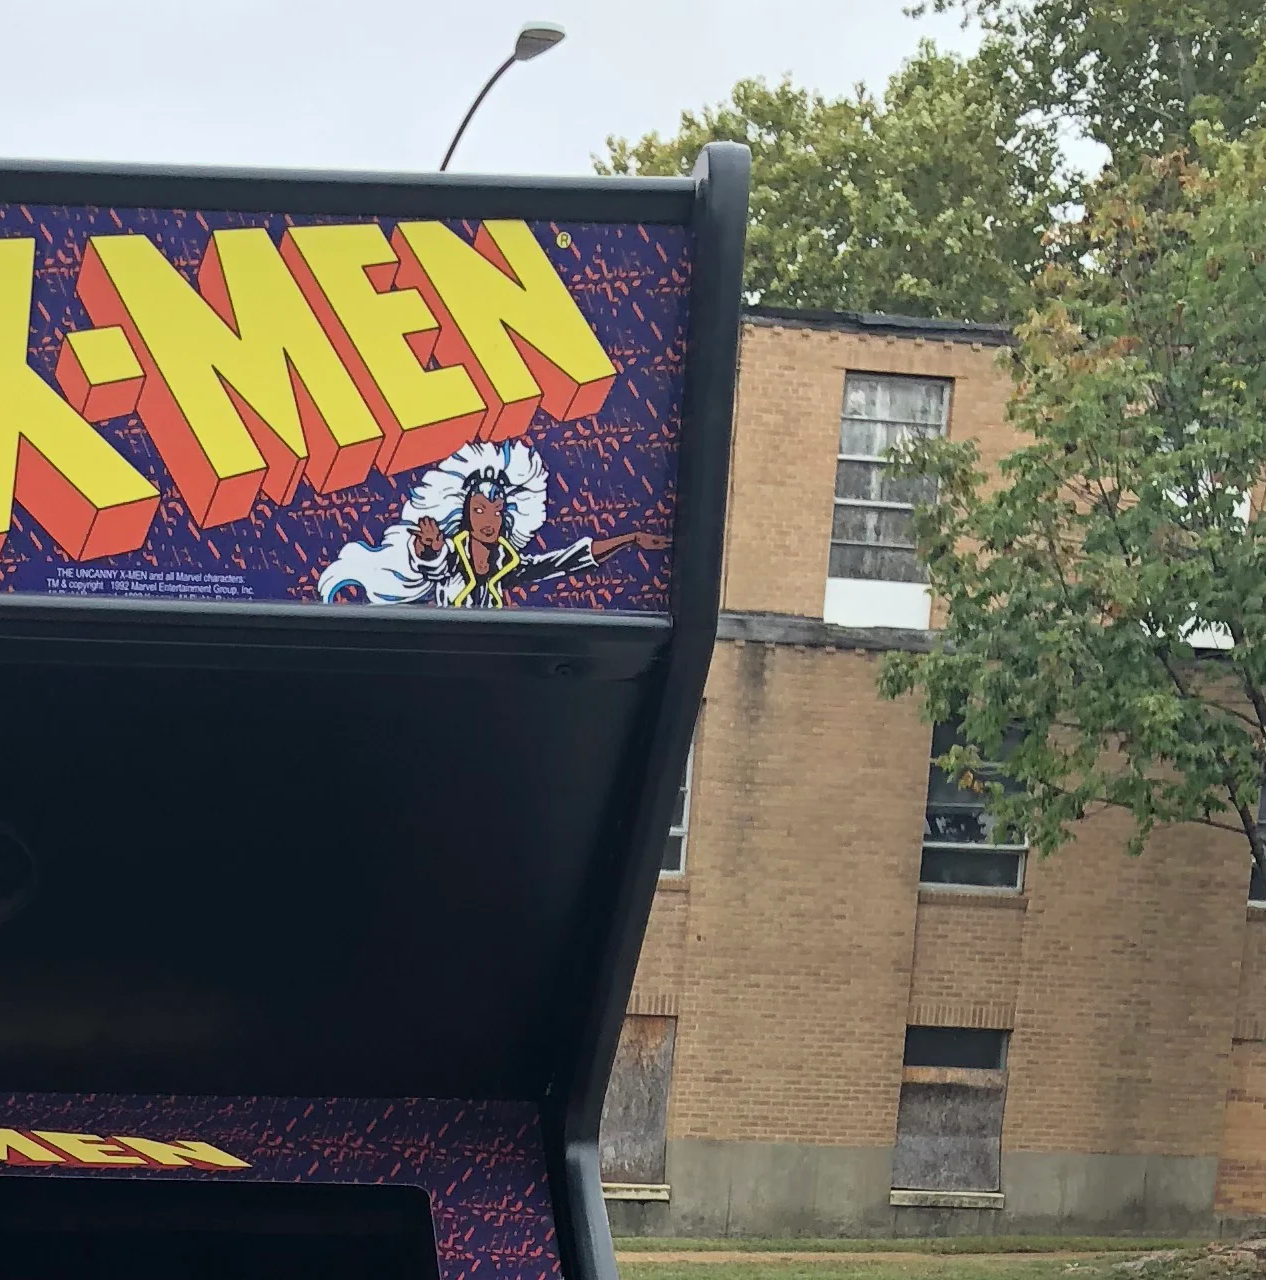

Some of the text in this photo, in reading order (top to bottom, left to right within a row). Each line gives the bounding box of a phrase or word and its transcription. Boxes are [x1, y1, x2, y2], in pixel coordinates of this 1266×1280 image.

[57, 567, 74, 578] THE
[75, 568, 118, 579] UNCANNY
[119, 569, 147, 580] X-MEN
[149, 571, 164, 581] and
[165, 571, 174, 581] all
[176, 572, 202, 582] Marvel
[46, 578, 60, 588] TM
[61, 578, 67, 588] &
[68, 580, 104, 591] copyright
[111, 580, 130, 591] 1992
[131, 581, 157, 591] Marvel
[158, 582, 212, 593] Entertainment
[241, 586, 255, 595] Inc.
